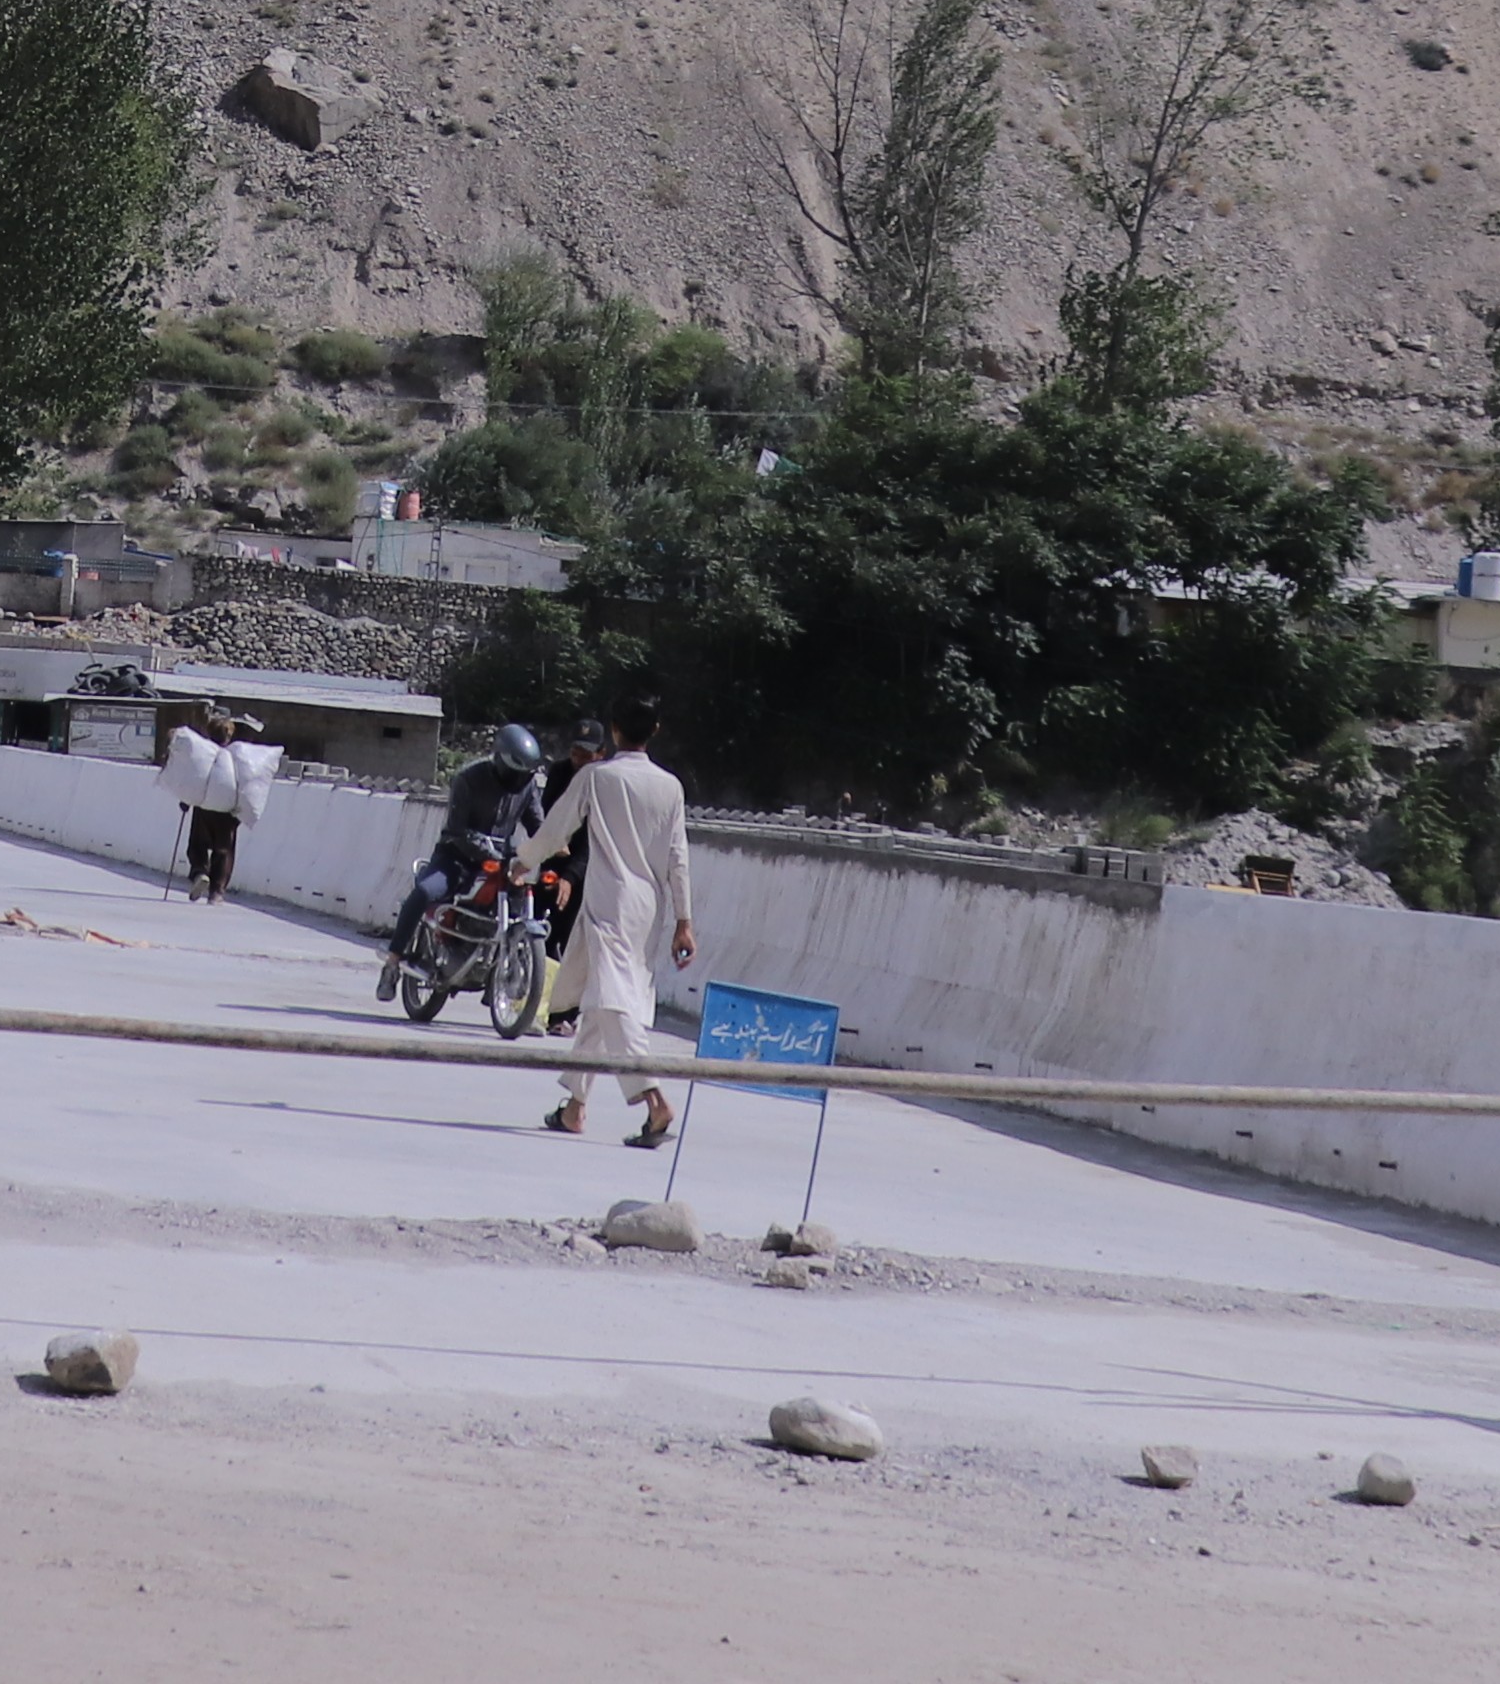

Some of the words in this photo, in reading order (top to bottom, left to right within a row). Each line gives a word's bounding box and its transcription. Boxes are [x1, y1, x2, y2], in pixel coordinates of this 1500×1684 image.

[711, 1022, 734, 1044] ہے
[734, 1024, 757, 1041] بند
[795, 1020, 829, 1057] آگے
